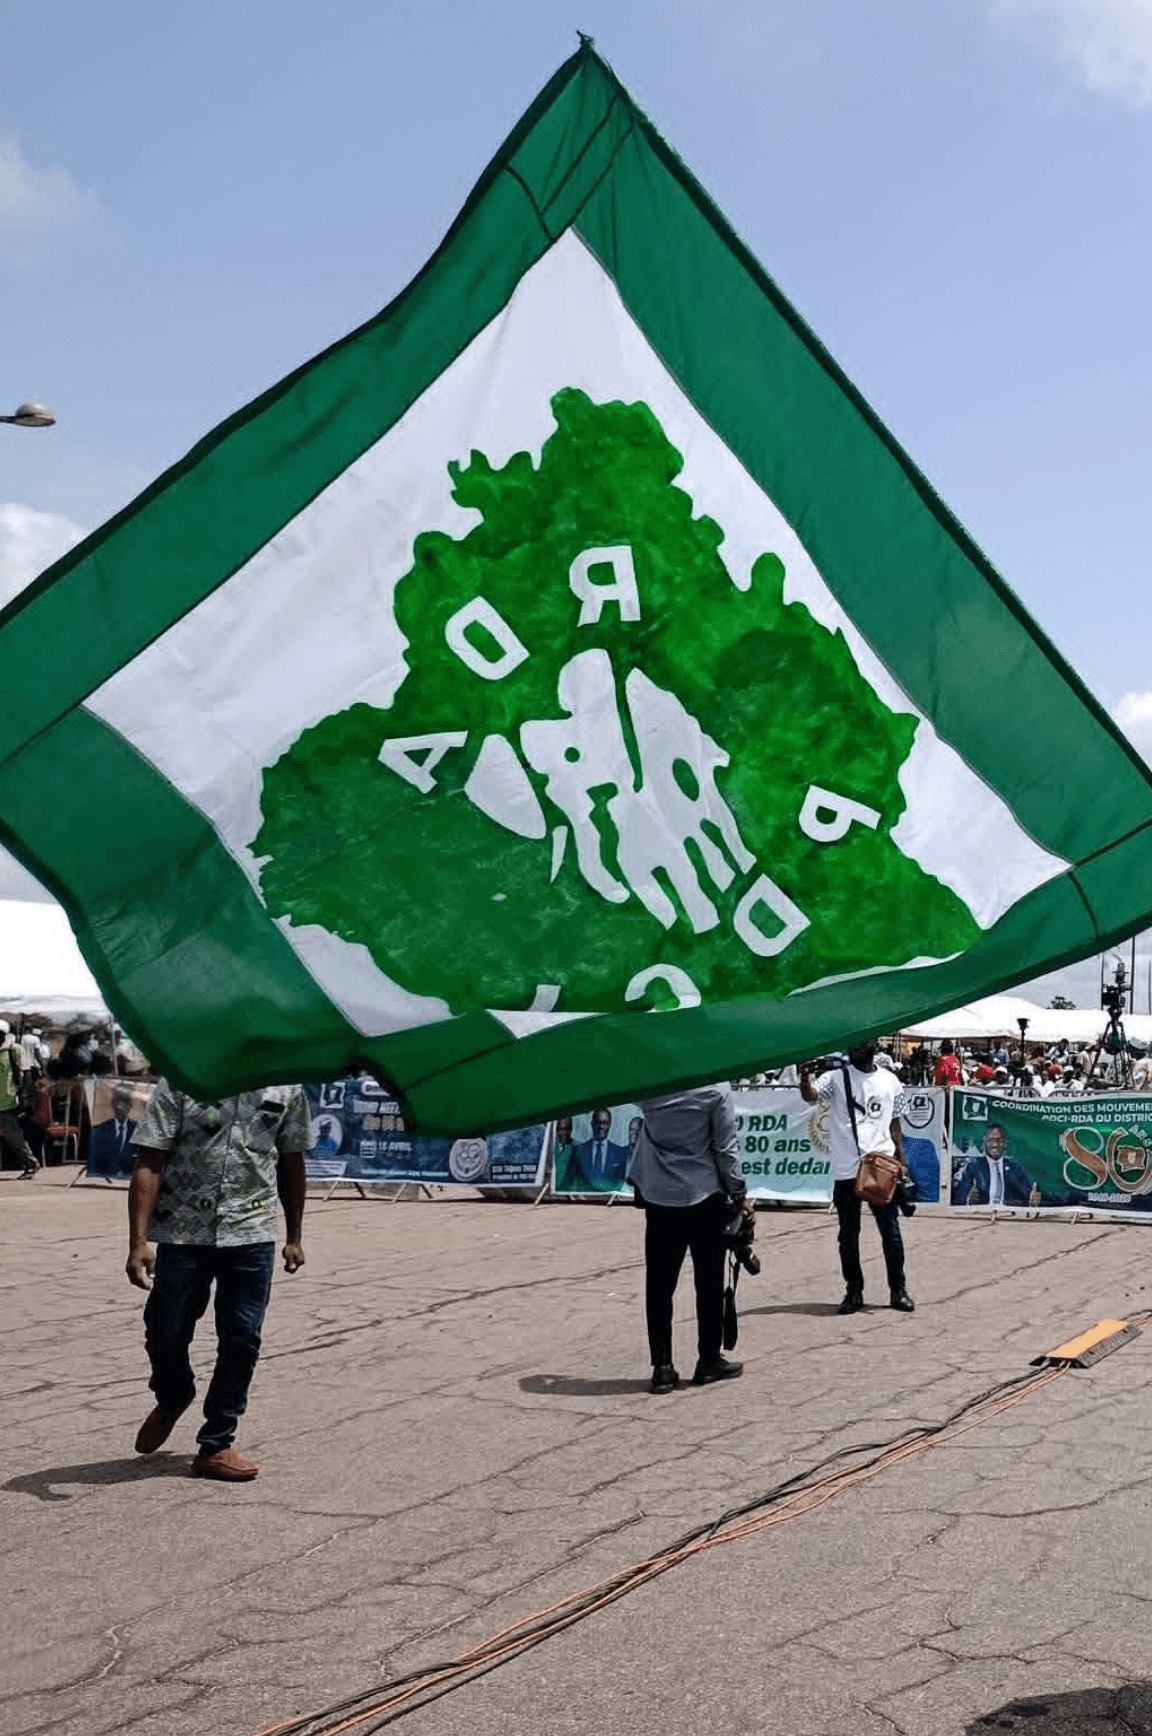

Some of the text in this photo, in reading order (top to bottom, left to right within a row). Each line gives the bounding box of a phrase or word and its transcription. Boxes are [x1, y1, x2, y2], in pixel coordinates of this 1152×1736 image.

[992, 1099, 1071, 1114] COORDINATION
[1073, 1104, 1095, 1114] DES
[748, 1114, 788, 1132] RDA
[1095, 1114, 1111, 1123] DU
[745, 1136, 769, 1153] 80
[774, 1139, 811, 1153] ans
[741, 1157, 771, 1175] est
